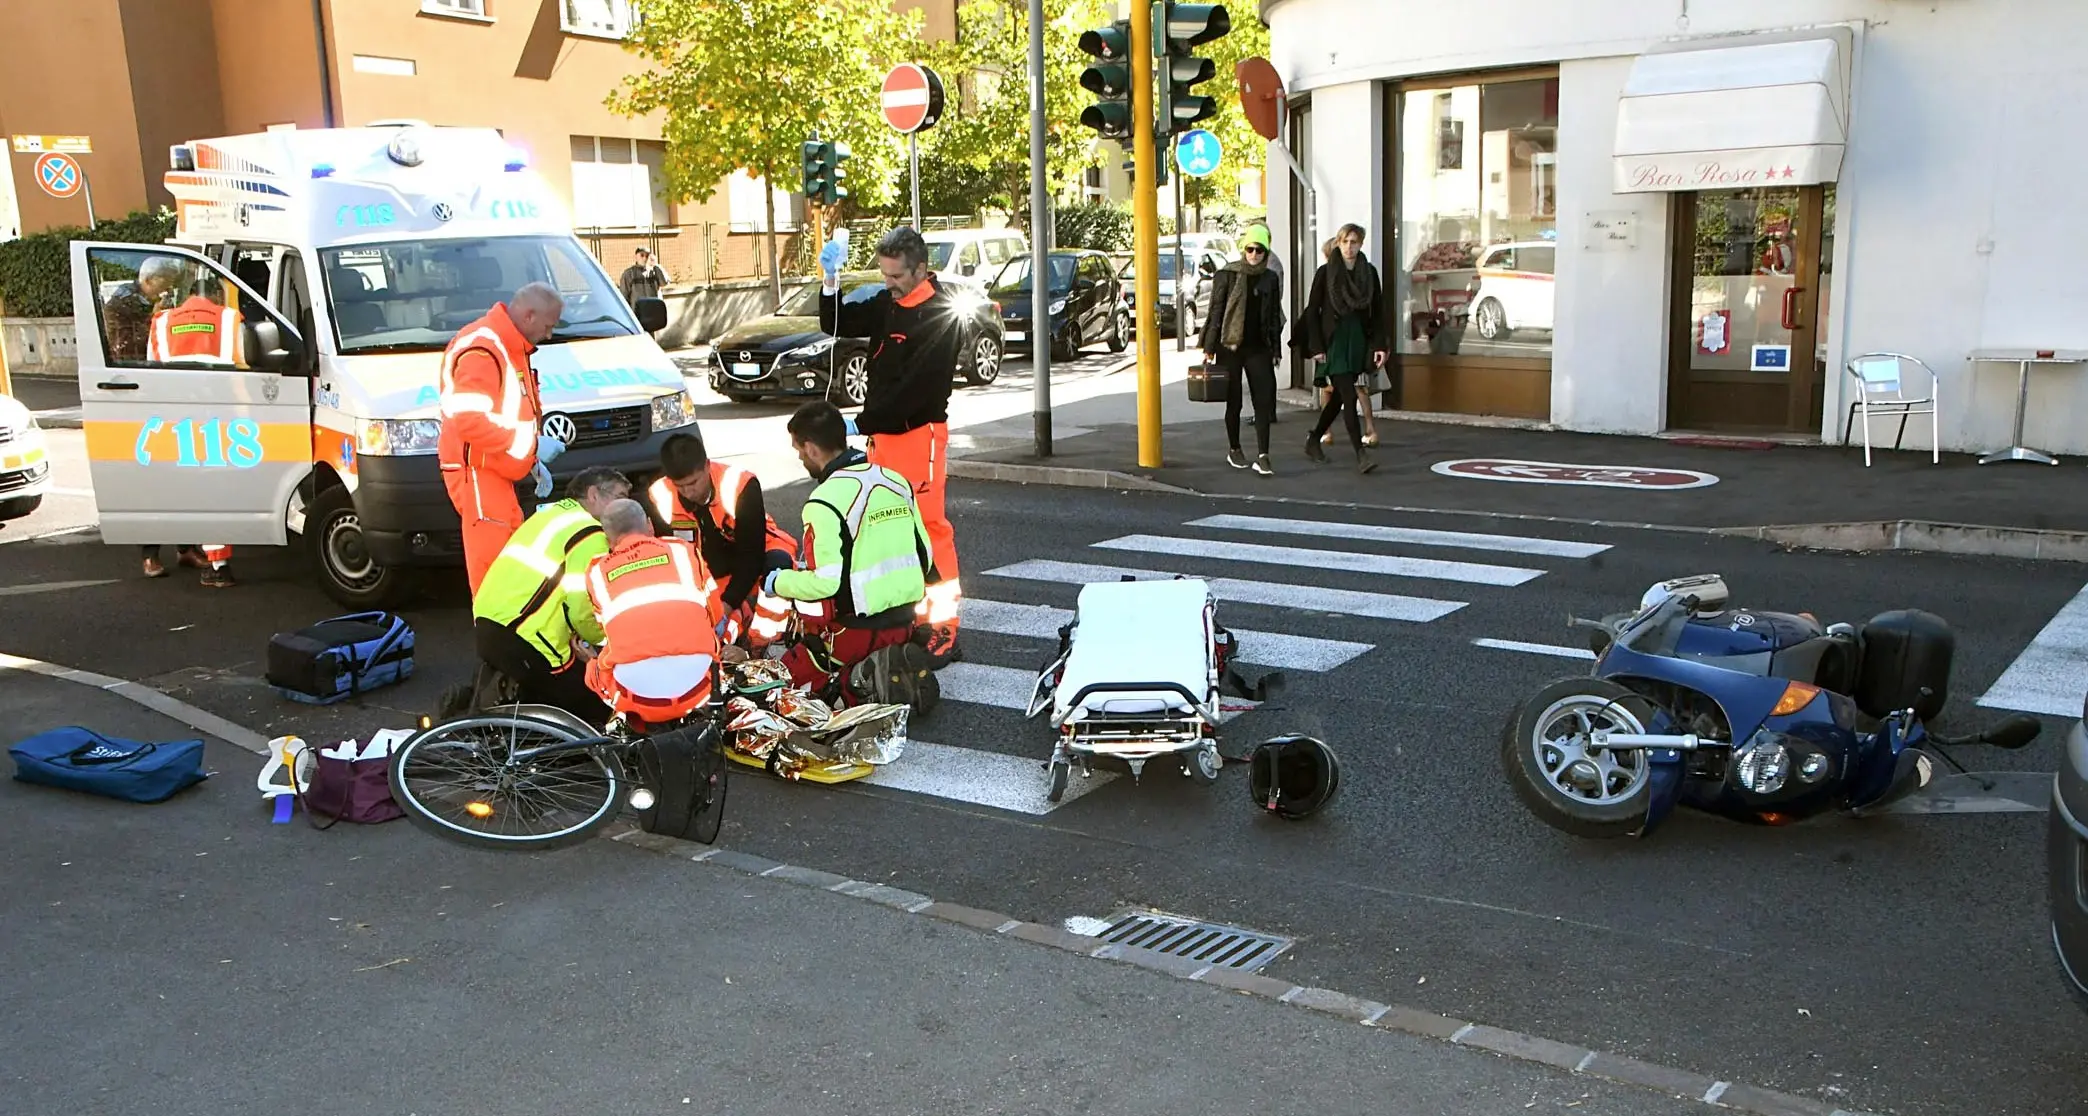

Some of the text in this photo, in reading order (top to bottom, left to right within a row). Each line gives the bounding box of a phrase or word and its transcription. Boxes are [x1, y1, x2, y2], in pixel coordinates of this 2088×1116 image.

[1630, 161, 1757, 188] Bar Rosa
[352, 203, 396, 227] 118
[171, 417, 264, 468] 118
